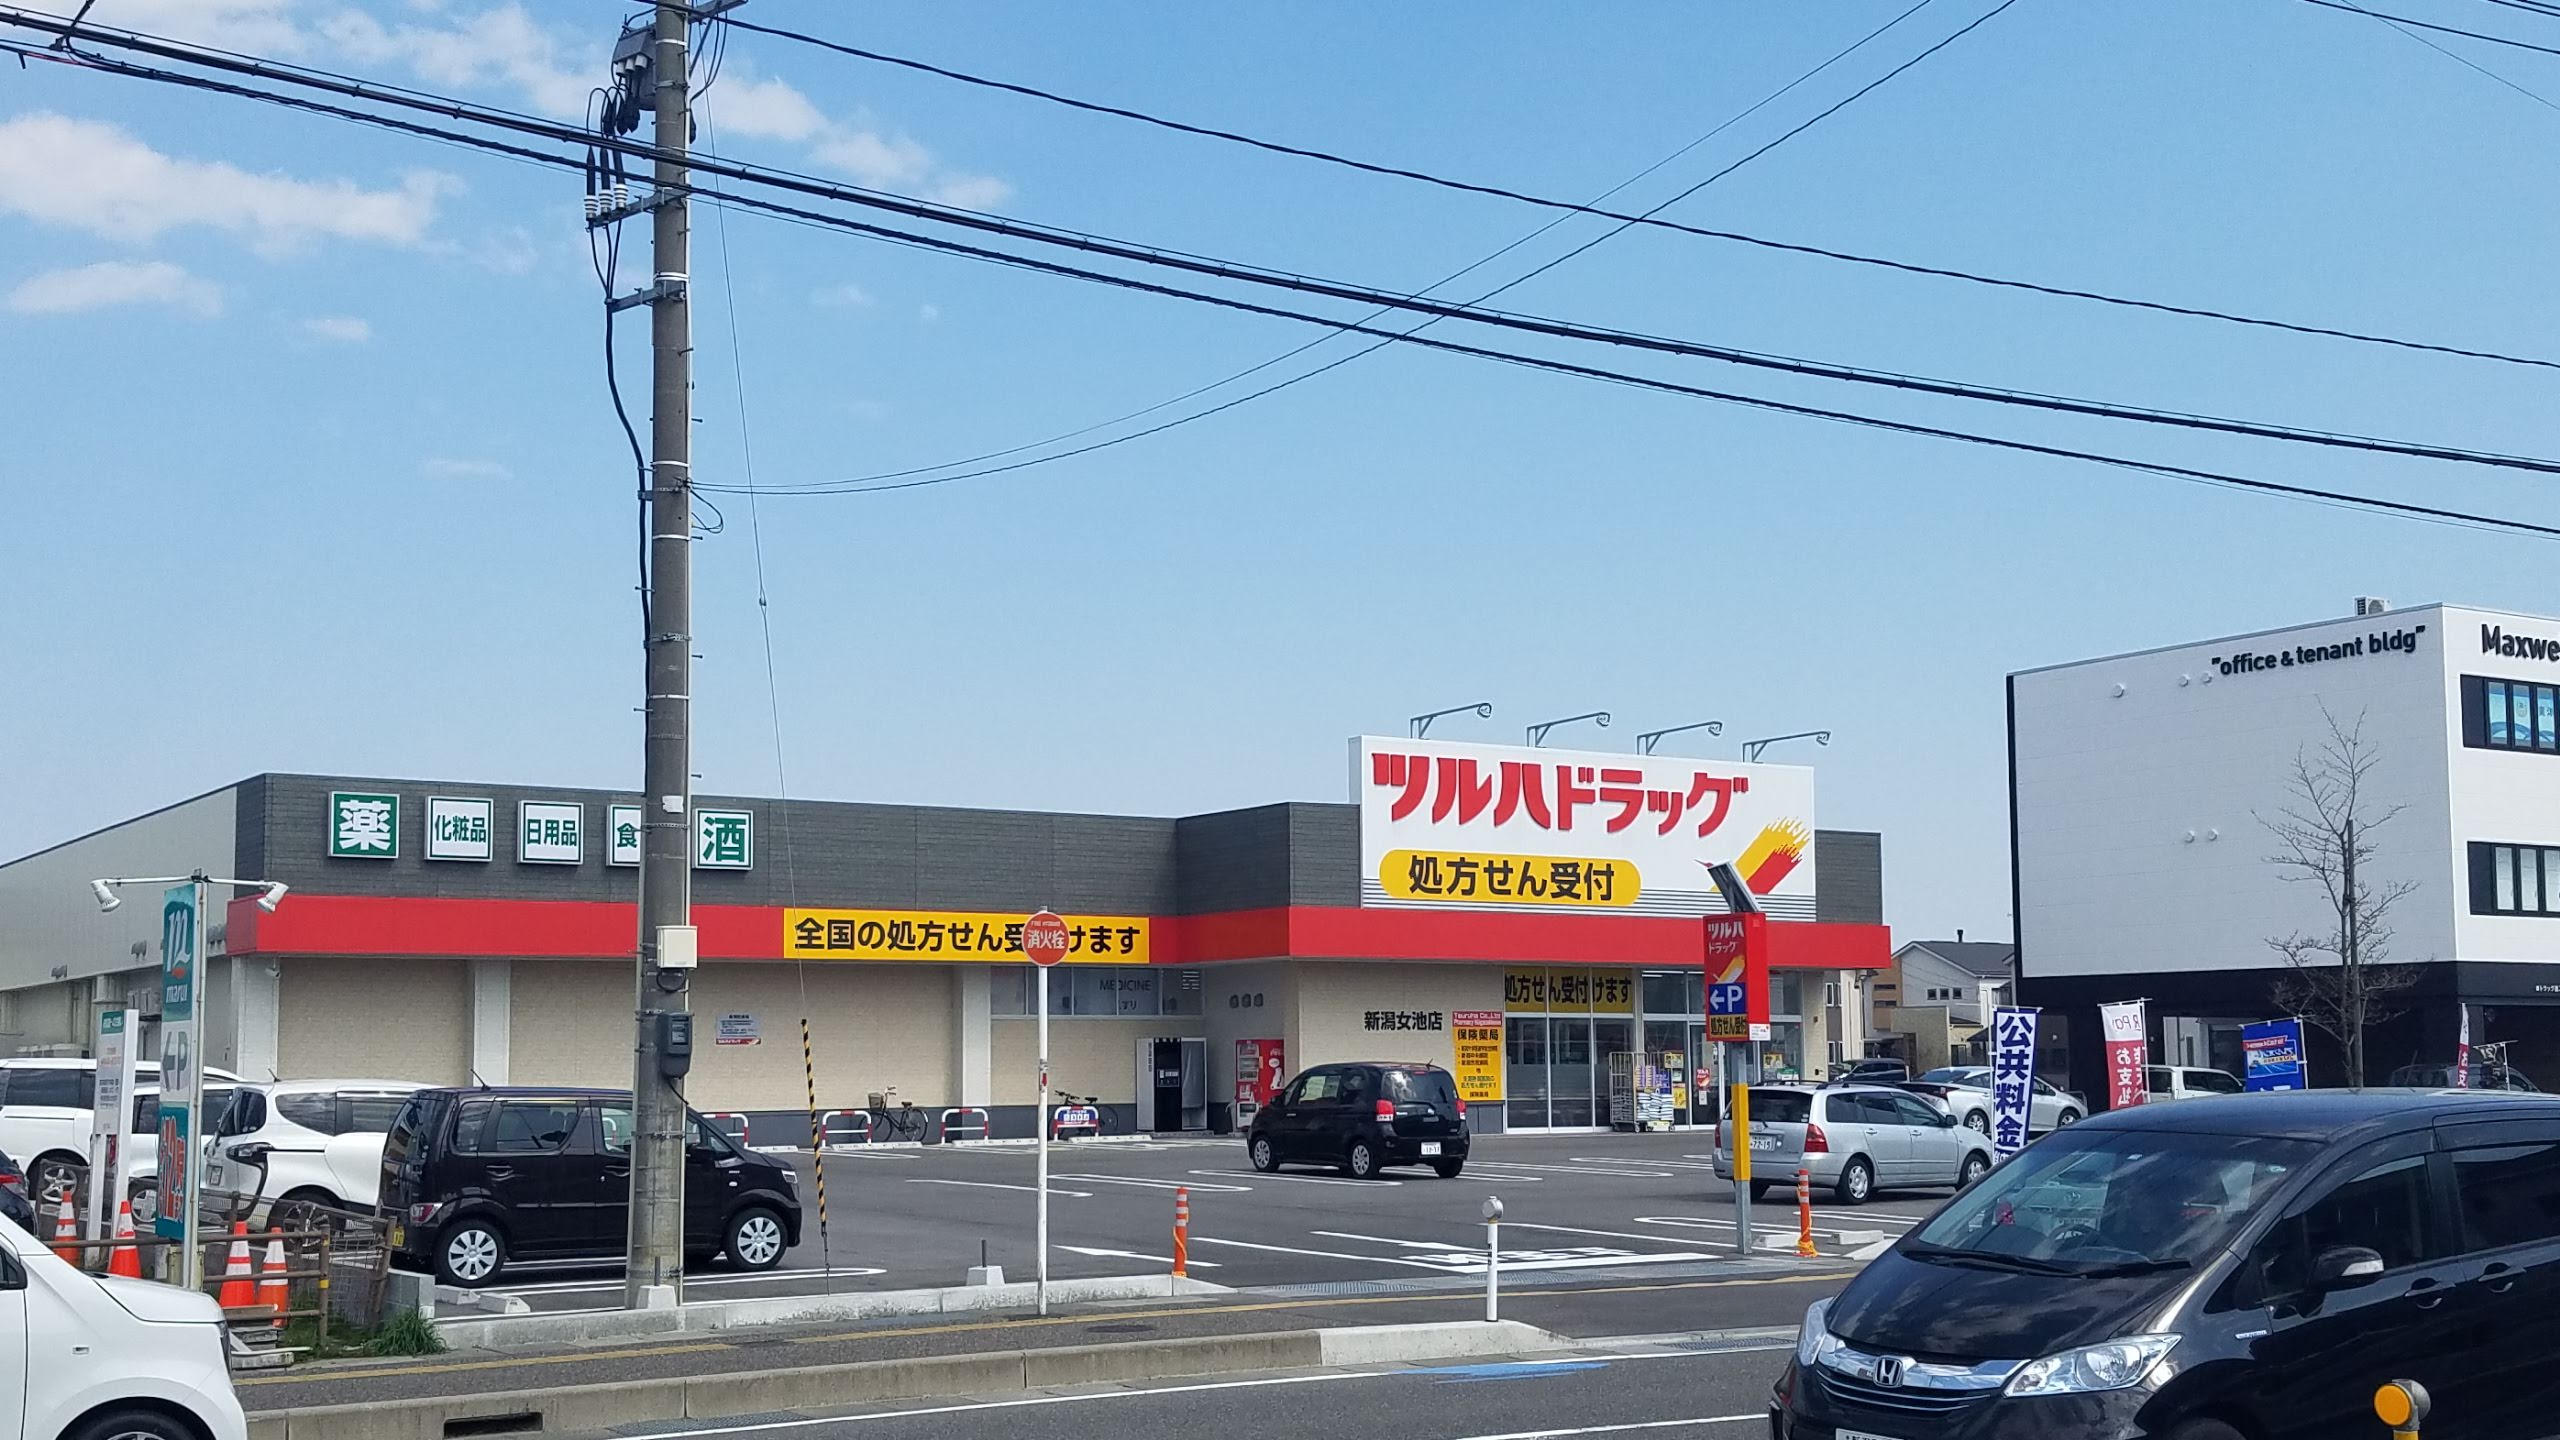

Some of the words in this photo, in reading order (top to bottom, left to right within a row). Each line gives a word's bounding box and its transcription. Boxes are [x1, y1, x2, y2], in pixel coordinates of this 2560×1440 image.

[2296, 637, 2363, 665] tenant
[1371, 752, 1749, 839] ツルハドラッグ
[339, 800, 392, 851] 薬
[434, 814, 486, 843] 化粧品
[526, 819, 578, 847] 日用品
[703, 816, 747, 862] 酒
[1408, 854, 1615, 901] 処方せん受付
[794, 917, 1140, 955] 全国の処方せん受けます
[1027, 929, 1066, 949] 消火栓
[1707, 921, 1745, 940] ツルハ
[1099, 980, 1151, 991] MEDICINE
[1504, 974, 1632, 1004] 処方せん受付けます
[1727, 985, 1743, 1012] P
[1364, 1011, 1443, 1031] 新潟女池店
[177, 1031, 191, 1091] P
[1995, 1015, 2034, 1148] 公共料金
